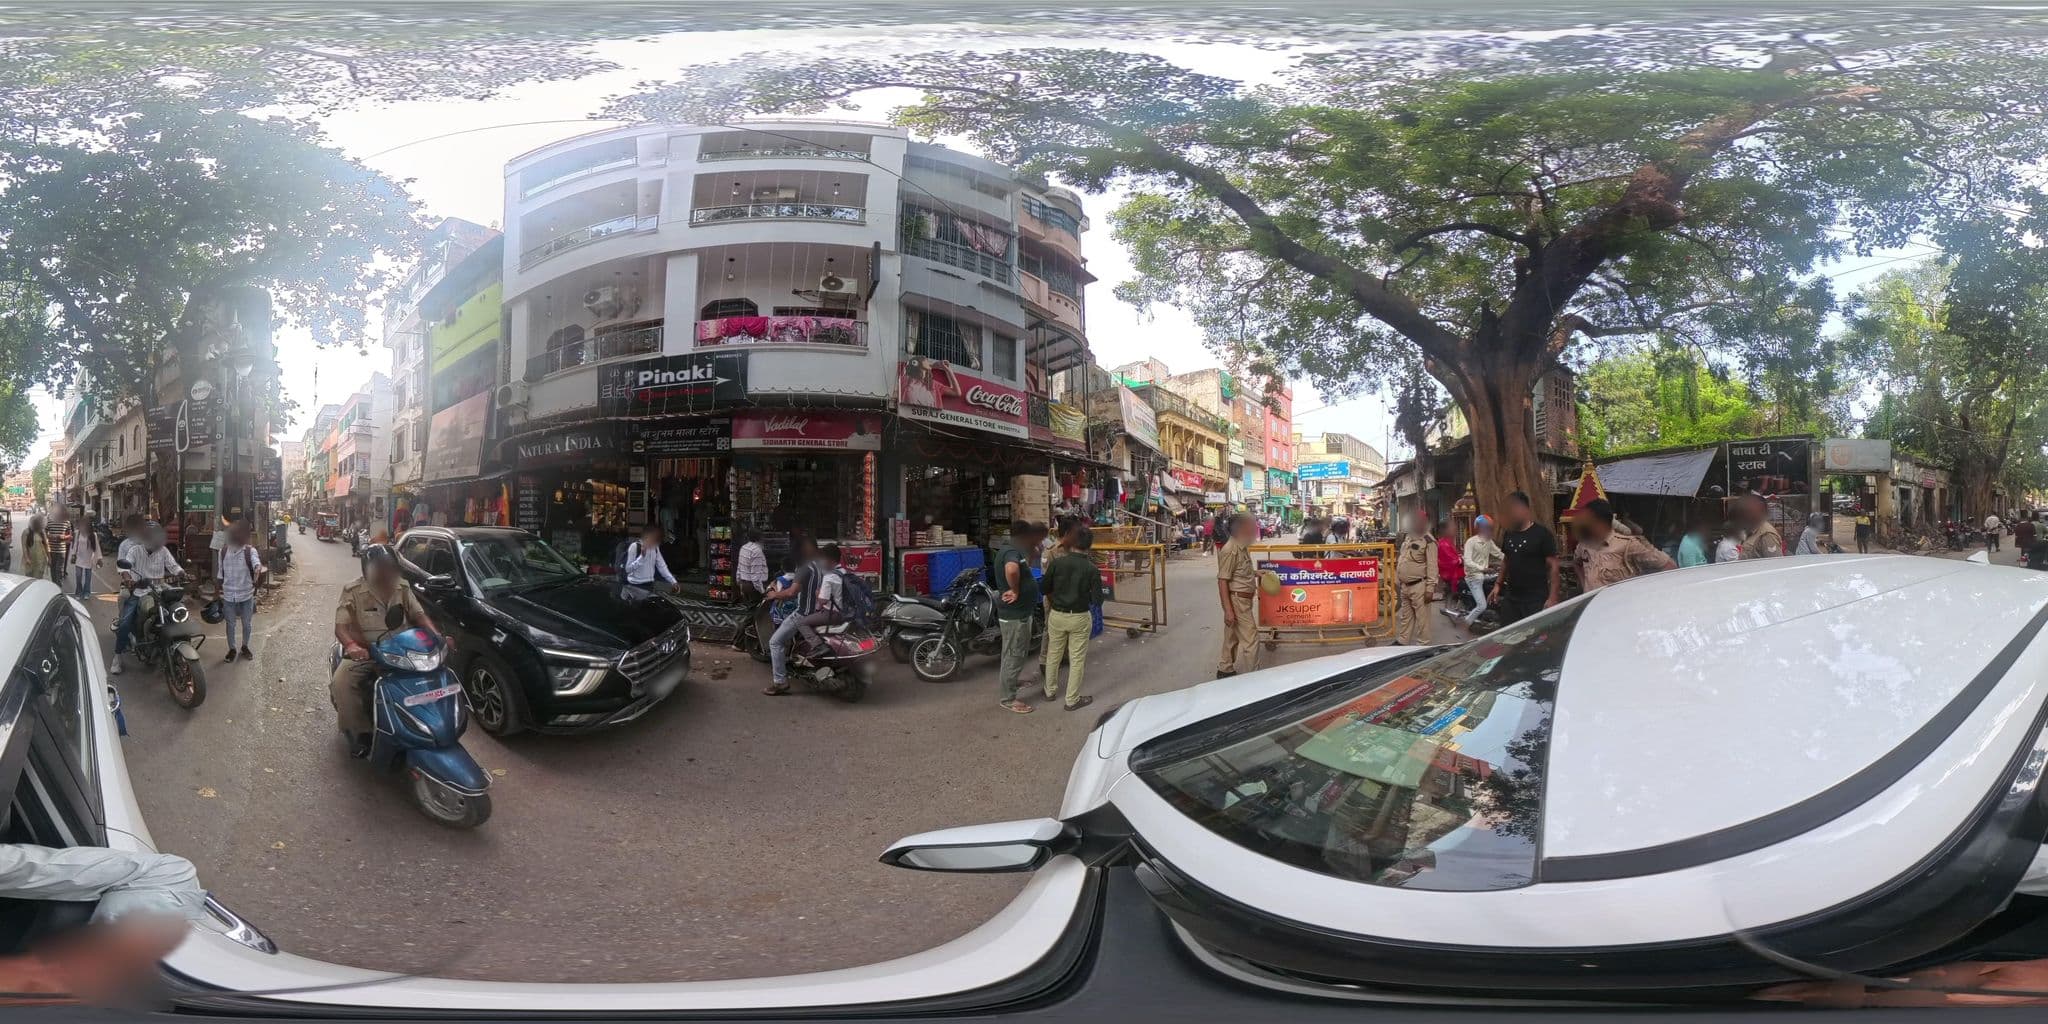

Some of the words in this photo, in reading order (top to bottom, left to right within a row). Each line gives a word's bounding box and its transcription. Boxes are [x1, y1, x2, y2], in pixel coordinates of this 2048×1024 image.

[638, 363, 713, 386] Pinaki
[966, 385, 1024, 416] Coca-Cola
[763, 415, 809, 435] Vadilal
[911, 408, 939, 418] SURAJ
[940, 412, 974, 425] GENERAL
[974, 417, 996, 429] STORE
[519, 443, 561, 458] NATURA
[565, 436, 602, 451] INDIA
[797, 439, 827, 447] GENERAL
[827, 440, 848, 448] STORE
[1732, 446, 1756, 456] बाबा
[1759, 443, 1771, 455] टी
[1737, 460, 1767, 470] स्टाल
[1340, 567, 1376, 579] वाराणसी
